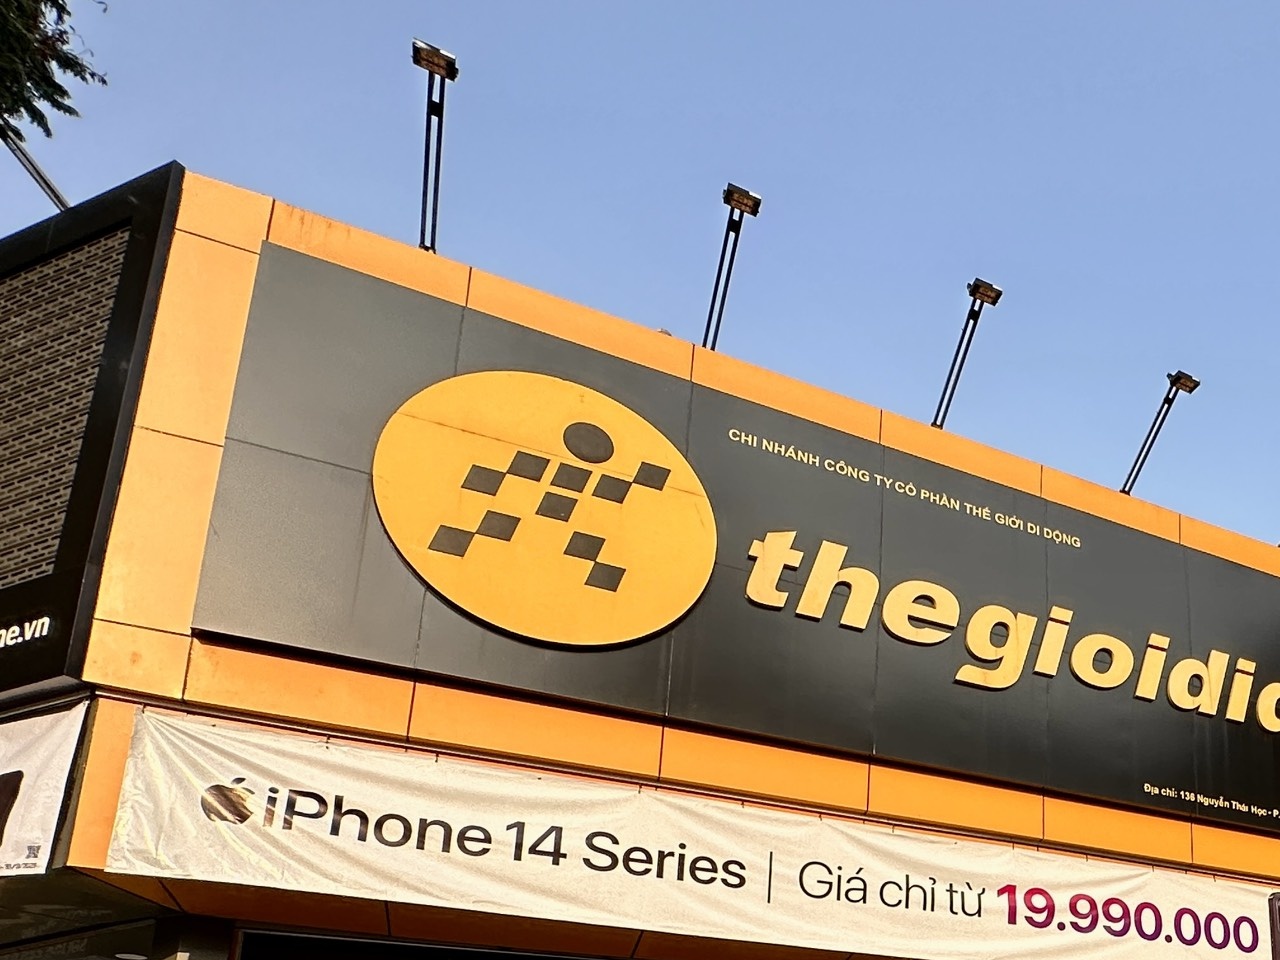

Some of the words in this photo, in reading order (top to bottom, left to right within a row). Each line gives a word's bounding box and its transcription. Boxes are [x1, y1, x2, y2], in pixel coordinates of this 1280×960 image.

[729, 429, 757, 448] CHI
[762, 440, 820, 467] NHÁNH
[824, 458, 870, 482] CÔNG
[874, 474, 893, 489] TY
[995, 513, 1024, 530] GIỚI
[1027, 522, 1040, 535] DI
[262, 787, 493, 857] iPhone
[506, 821, 567, 867] 14
[583, 831, 748, 890] Series
[1144, 783, 1159, 796] Địa
[1197, 794, 1230, 809] Nguyễn
[1250, 805, 1267, 817] Học
[798, 858, 869, 904] Giá
[878, 870, 938, 914] chỉ
[946, 883, 985, 919] từ
[997, 882, 1259, 955] 19.990.000
